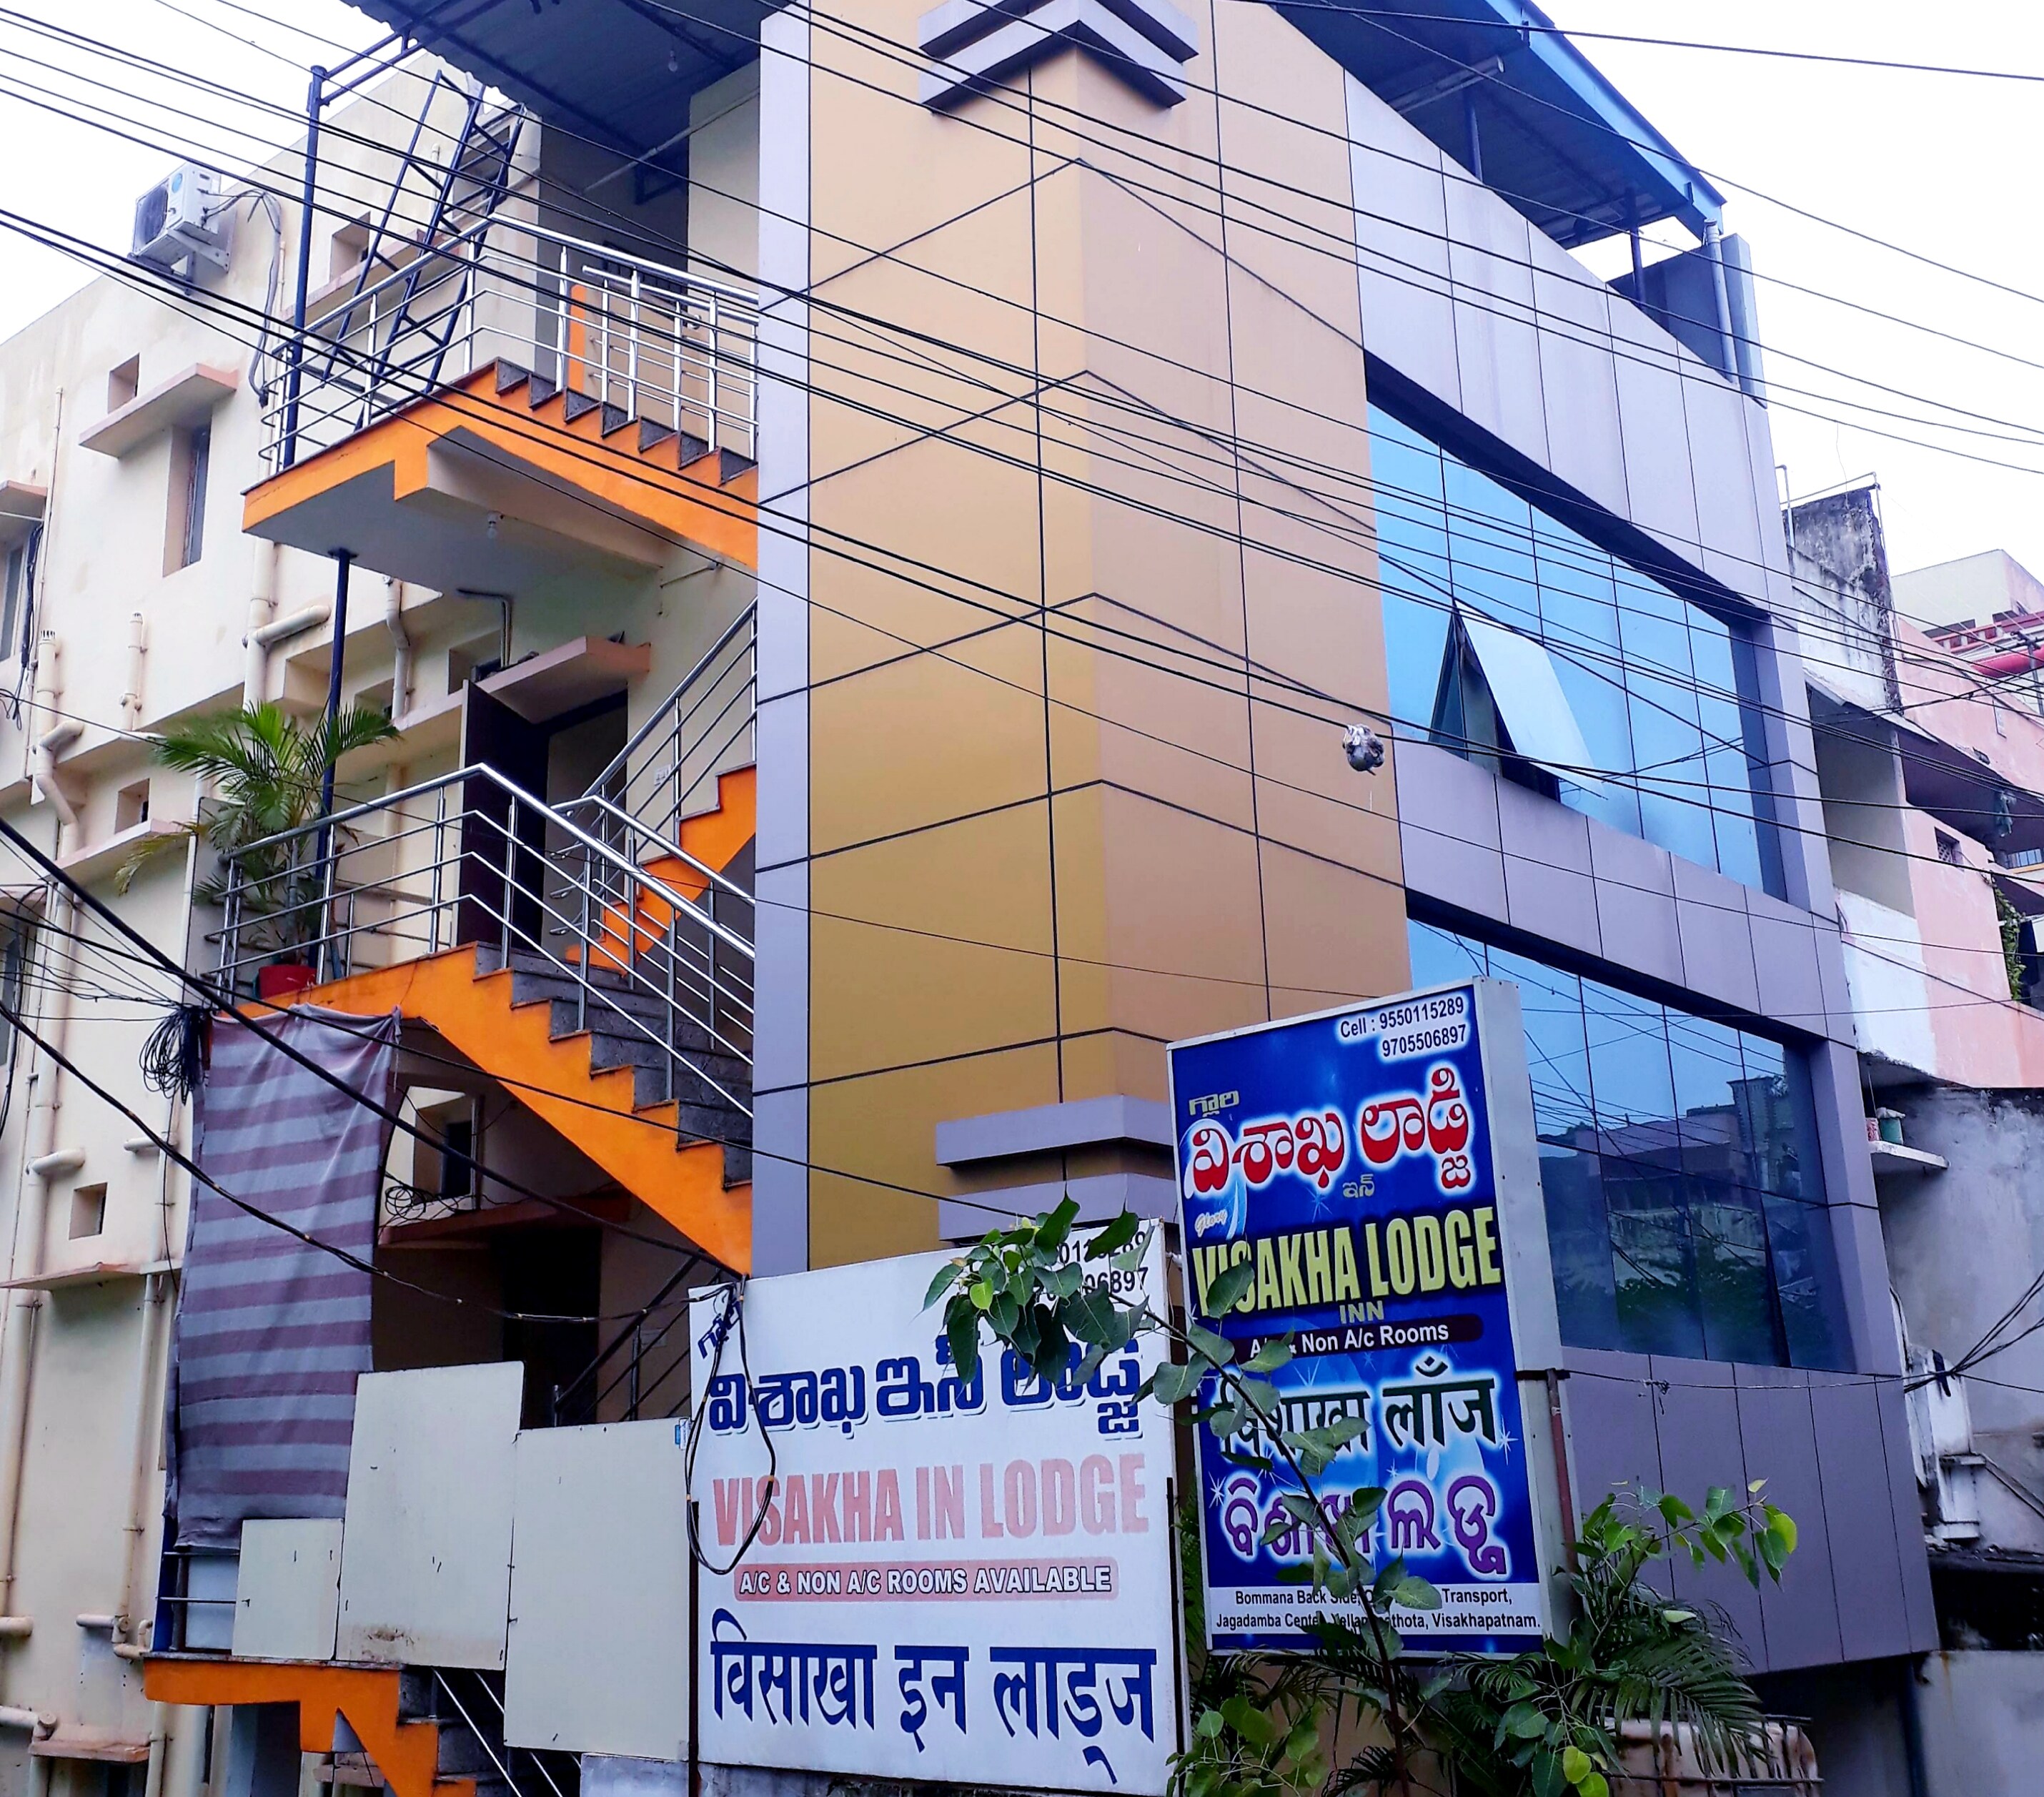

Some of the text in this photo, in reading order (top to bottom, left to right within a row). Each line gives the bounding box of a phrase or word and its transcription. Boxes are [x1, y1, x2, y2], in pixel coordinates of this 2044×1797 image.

[1340, 1018, 1366, 1038] Cell
[1379, 996, 1464, 1029] 9550115289
[1382, 1024, 1466, 1057] 9705506897
[1192, 1112, 1344, 1193] విశాఖ
[1342, 1173, 1375, 1198] ఇన్
[1194, 1209, 1228, 1237] Glory
[1365, 1207, 1501, 1297] LODGE
[1339, 1300, 1385, 1325] INN
[1301, 1333, 1339, 1353] Non
[1344, 1327, 1374, 1350] A/c
[1379, 1324, 1449, 1346] Rooms
[710, 1365, 866, 1434] విశాఖ
[713, 1453, 1149, 1546] VISAKHA IN LODGE
[740, 1565, 1112, 1594] A/C & NON A/C ROOMS AVAILABLE
[1235, 1590, 1294, 1605] Bommana
[1296, 1590, 1326, 1604] Back
[1442, 1588, 1512, 1606] Transport,
[1216, 1613, 1281, 1630] Jagadamba
[1432, 1613, 1541, 1631] Visakhapatnam.
[710, 1608, 878, 1731] विसाखा
[894, 1645, 970, 1753] इन
